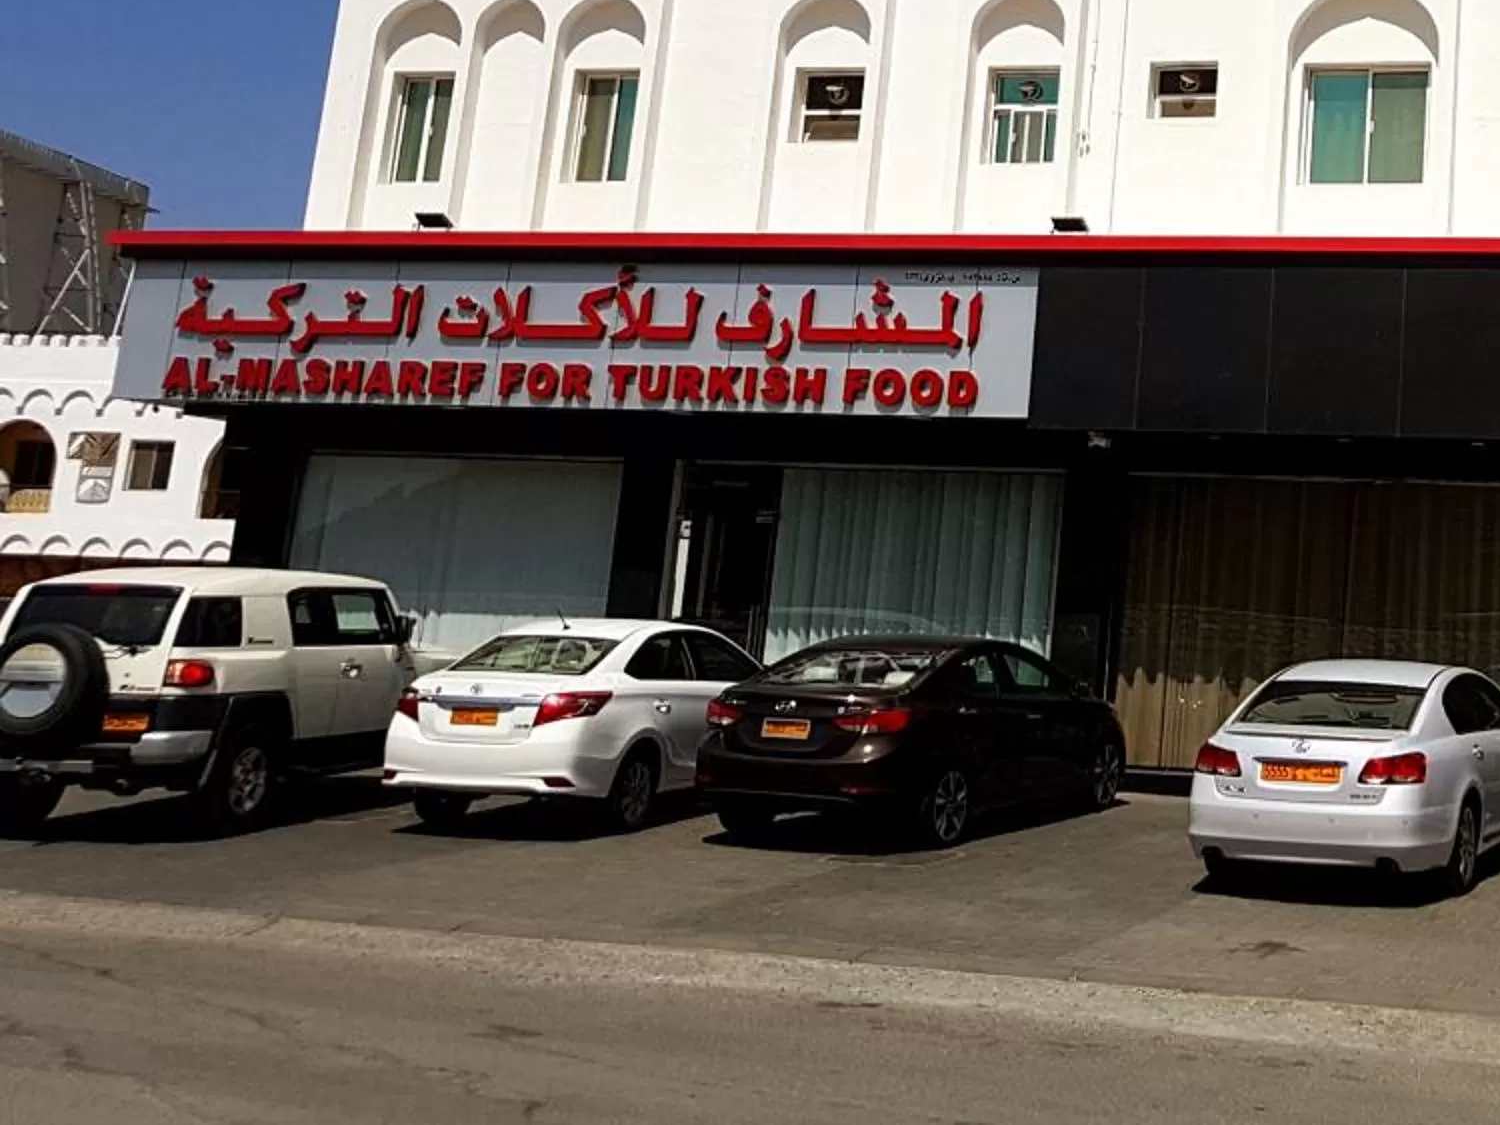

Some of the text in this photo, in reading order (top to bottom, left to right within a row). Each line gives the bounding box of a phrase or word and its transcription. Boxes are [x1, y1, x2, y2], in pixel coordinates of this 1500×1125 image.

[175, 265, 985, 362] المشارف للأكلات التركية
[162, 357, 981, 409] AL-MASHAREF FOR TURKISH FOOD
